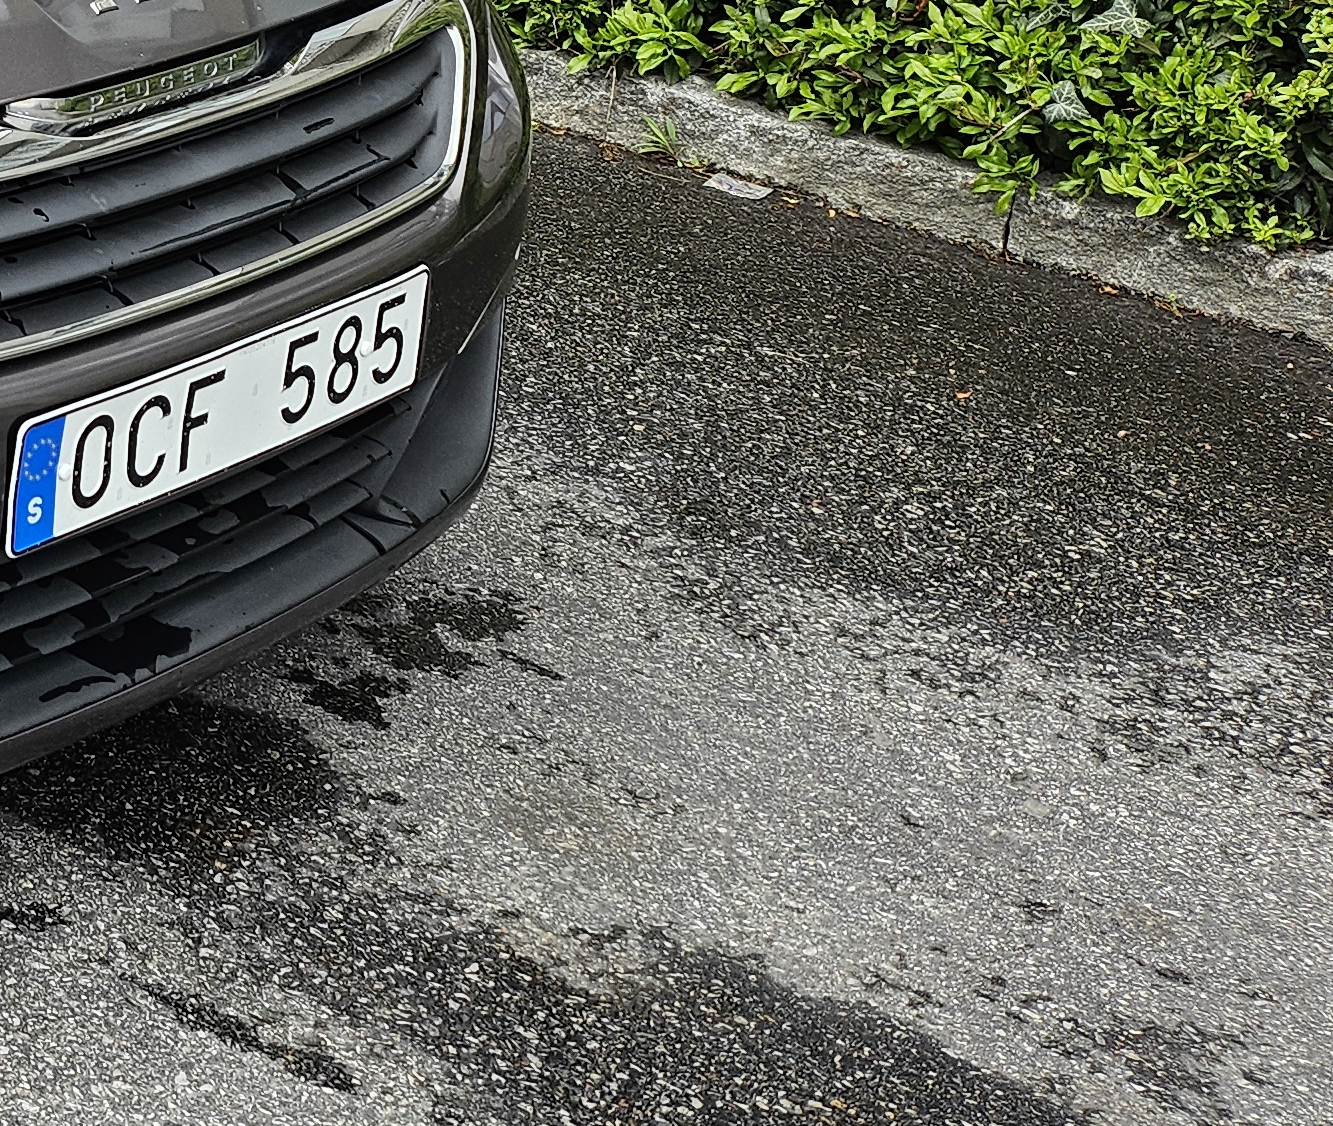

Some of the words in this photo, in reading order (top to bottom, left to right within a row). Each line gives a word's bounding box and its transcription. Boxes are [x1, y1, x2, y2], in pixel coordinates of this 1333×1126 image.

[89, 53, 237, 113] PEUGEOT
[71, 368, 227, 509] OCF
[280, 292, 408, 425] 585
[27, 496, 43, 524] S
